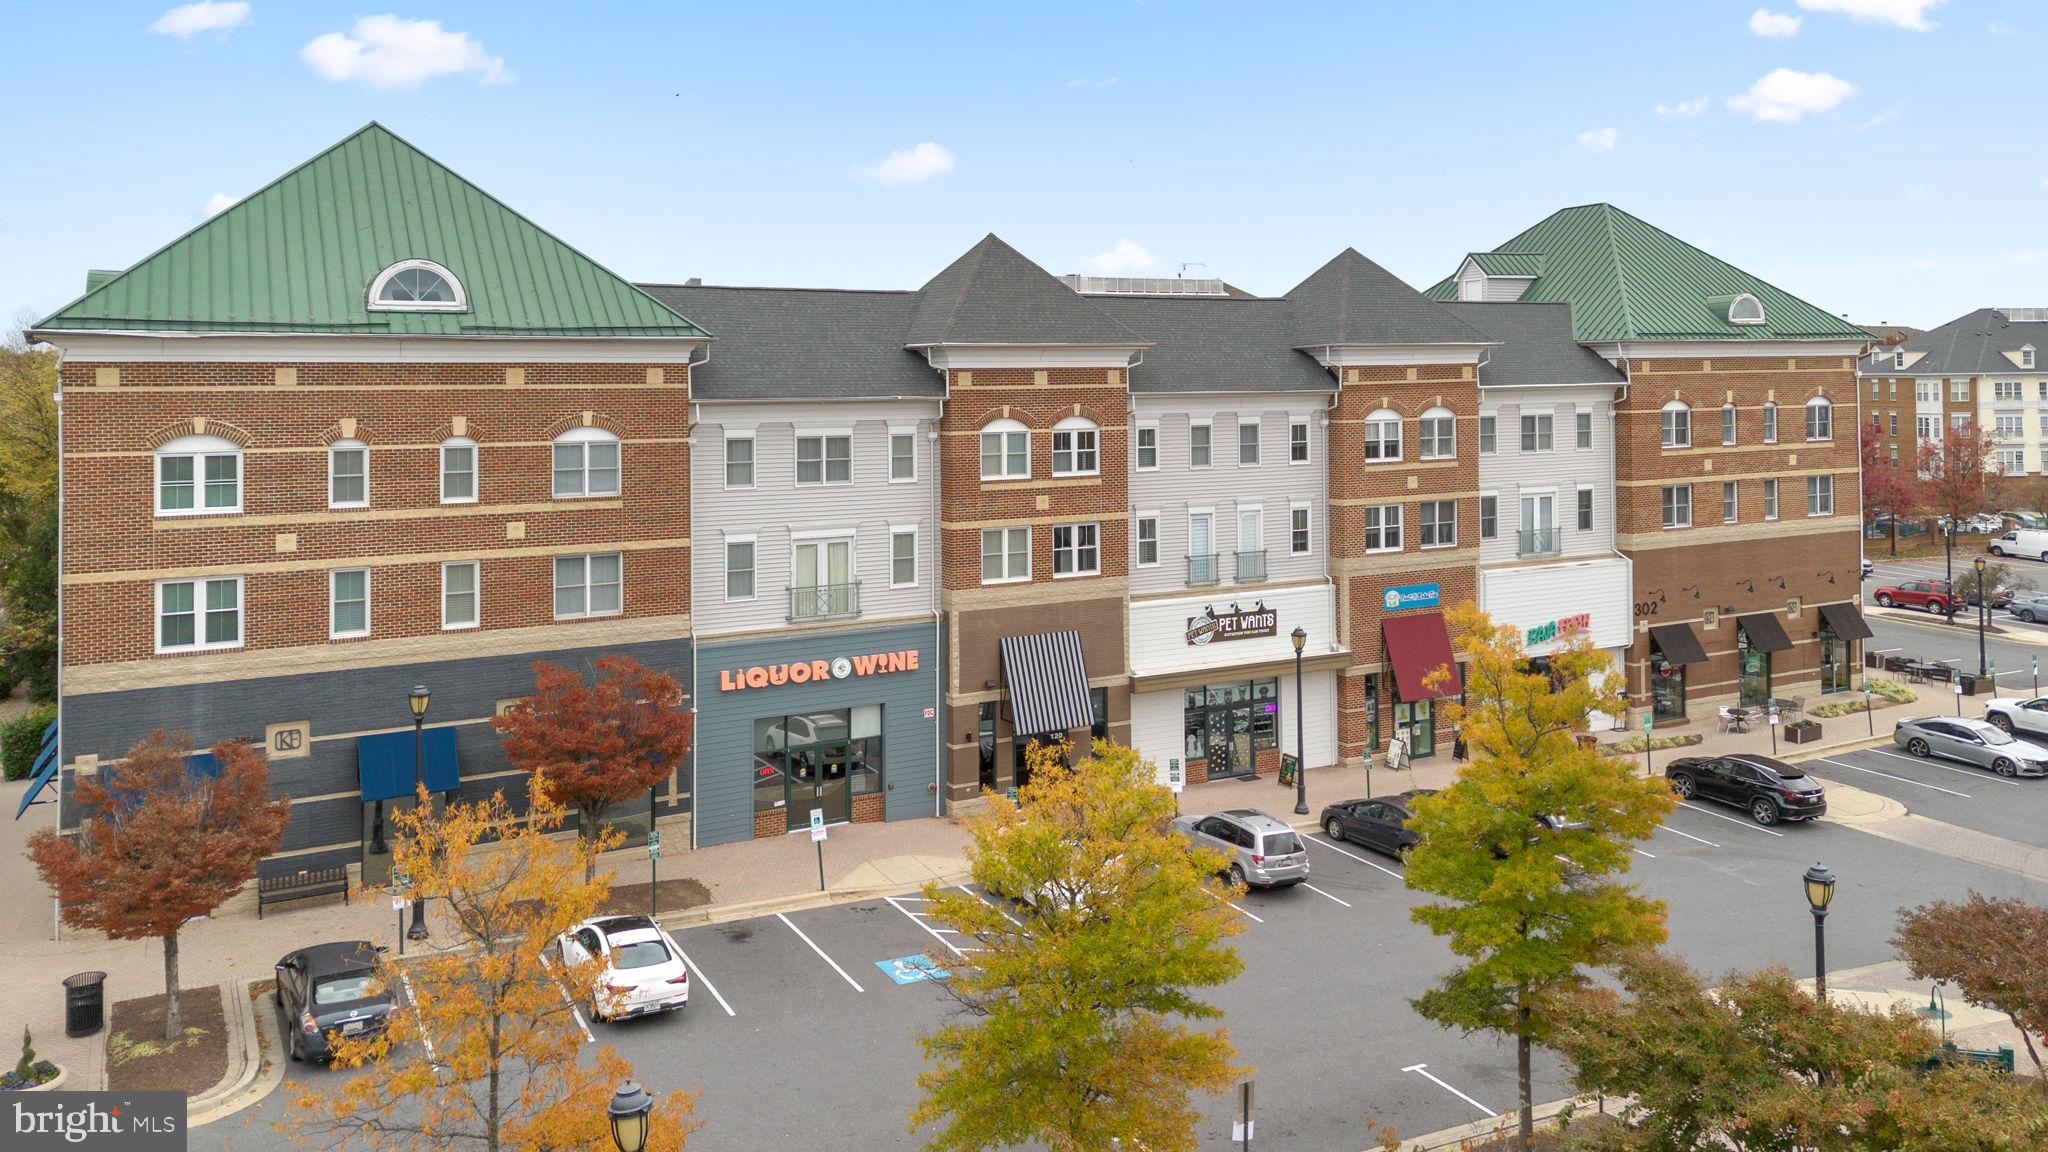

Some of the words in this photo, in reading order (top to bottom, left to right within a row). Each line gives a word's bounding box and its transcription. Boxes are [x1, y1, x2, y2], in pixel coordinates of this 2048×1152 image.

[1634, 601, 1658, 616] 302
[1219, 617, 1238, 631] PET
[1240, 613, 1274, 629] WANTS
[1187, 629, 1198, 639] PET
[1527, 620, 1556, 646] BAJA
[720, 660, 830, 692] LIQUOR
[852, 650, 919, 676] WINE
[759, 767, 775, 776] OPEN
